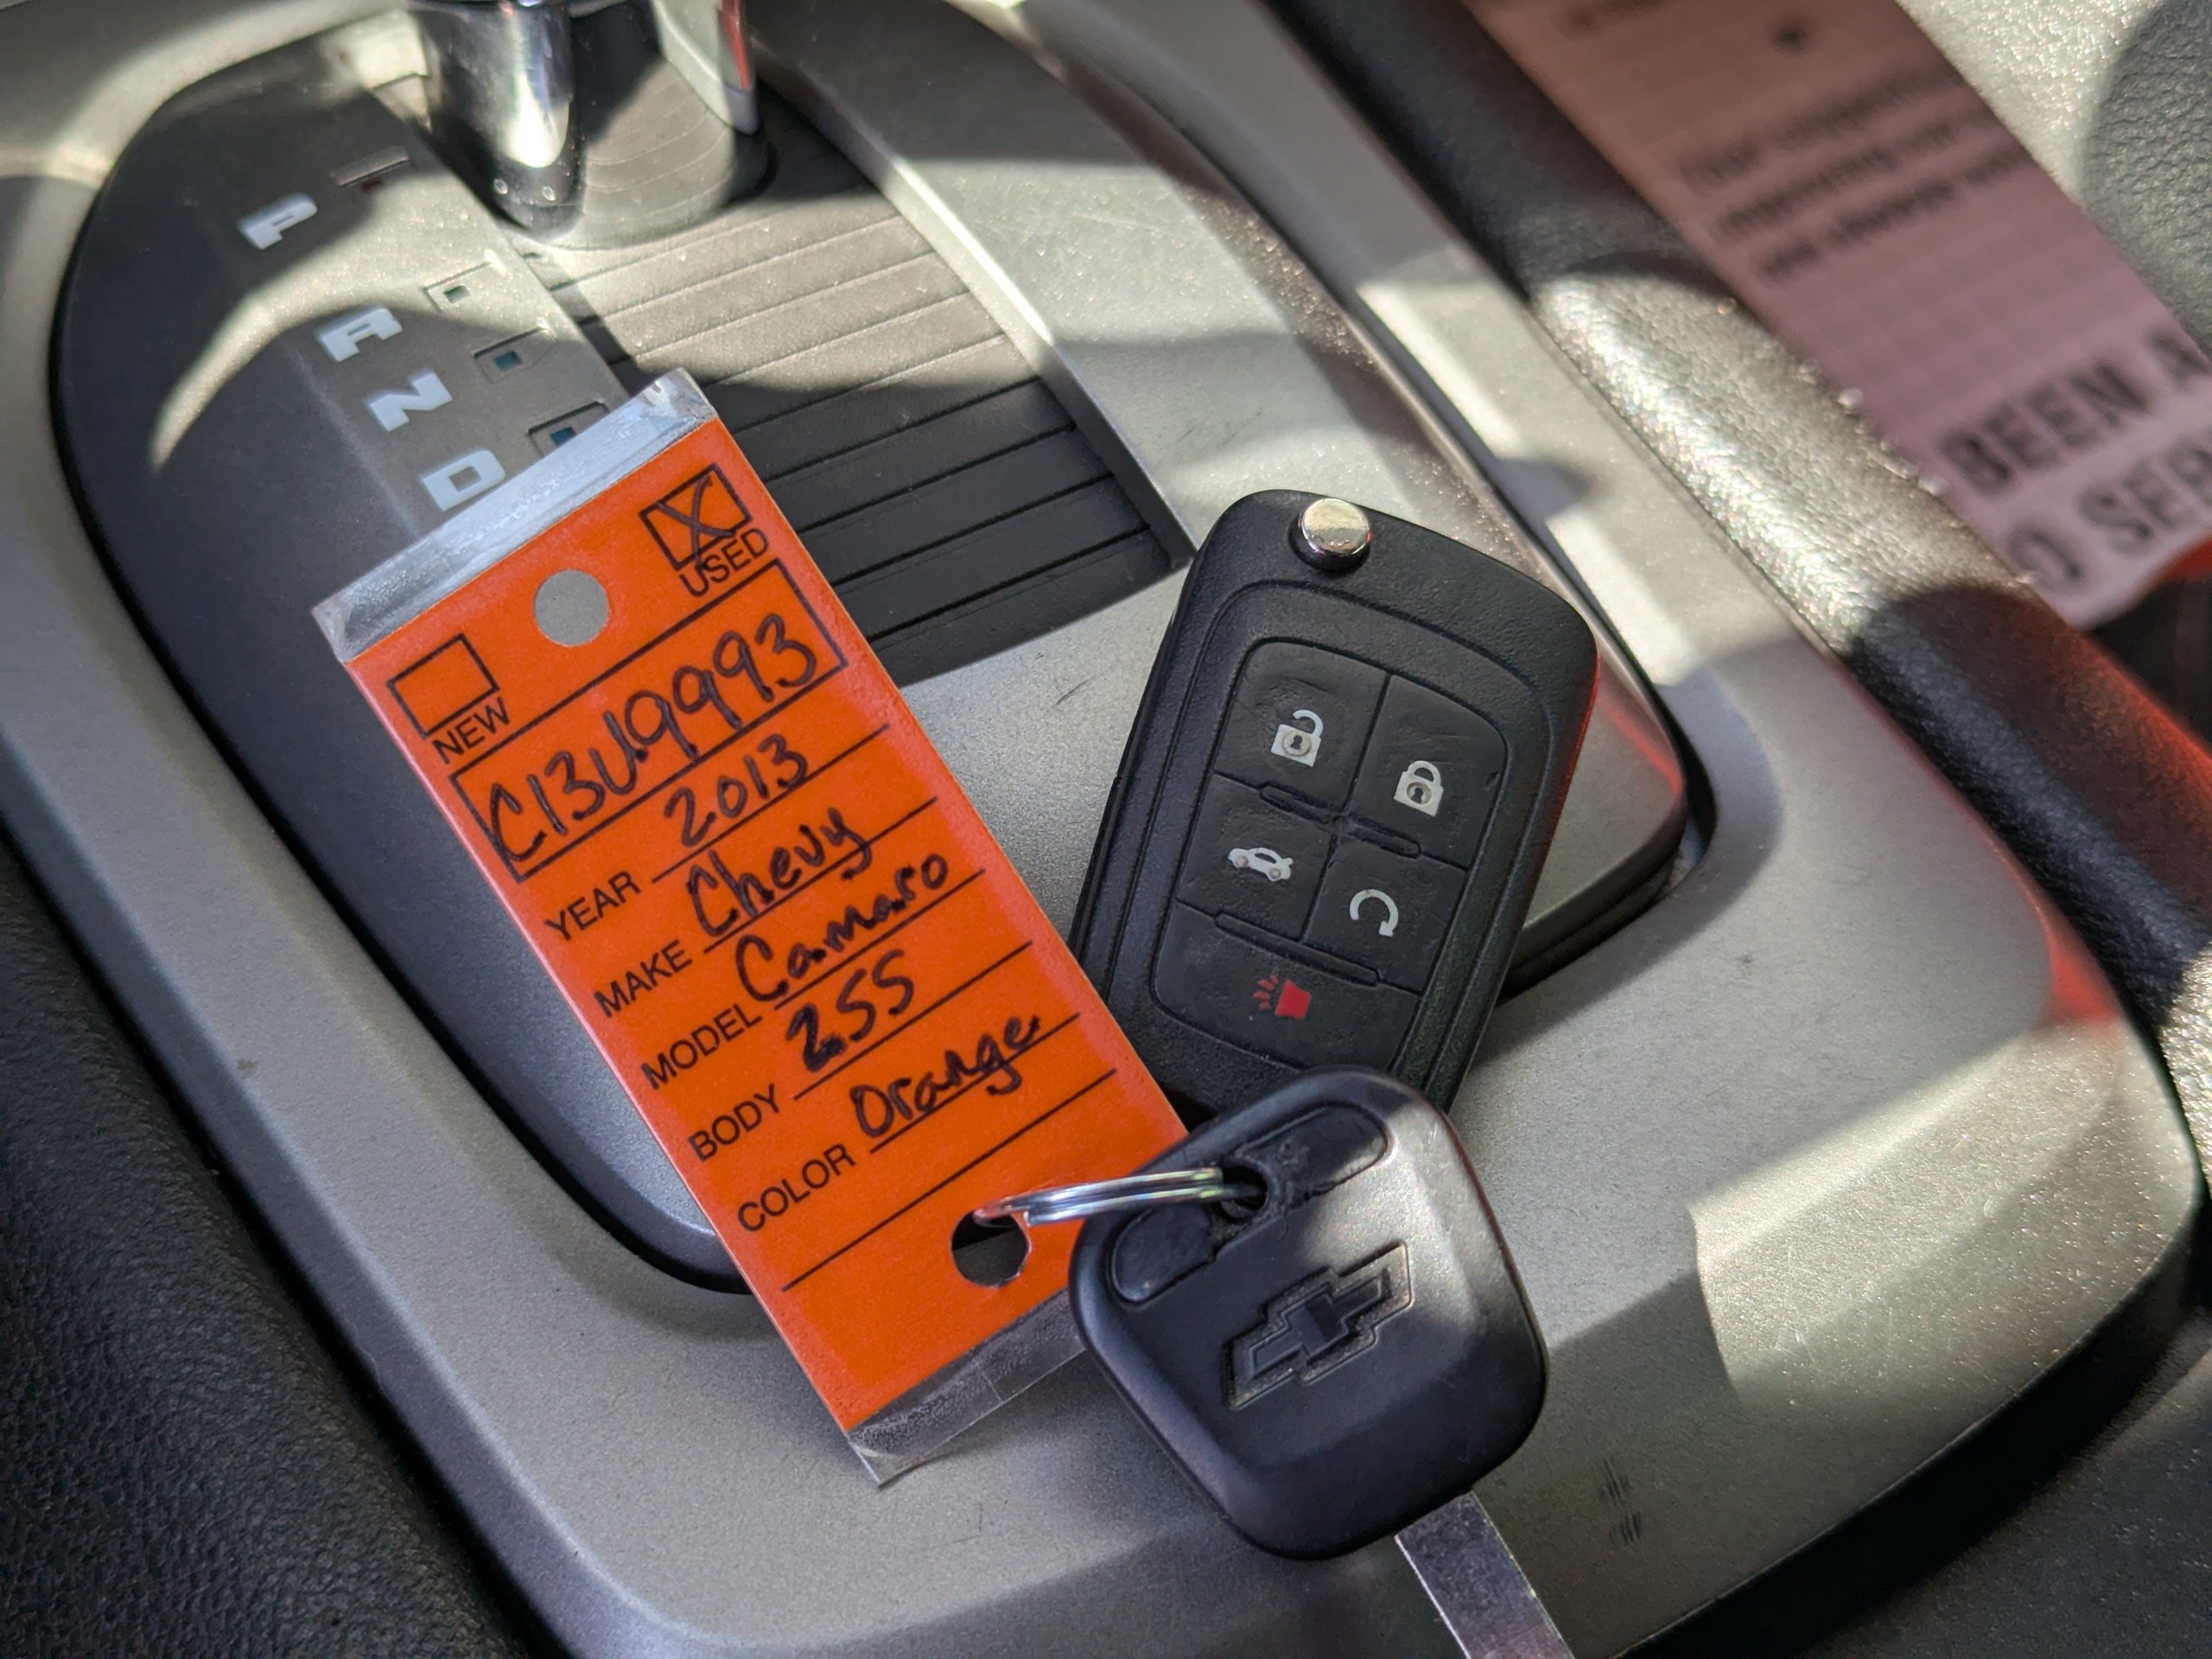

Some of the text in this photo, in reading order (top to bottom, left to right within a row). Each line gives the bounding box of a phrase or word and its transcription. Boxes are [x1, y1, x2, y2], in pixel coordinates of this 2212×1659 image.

[238, 193, 318, 250] P
[316, 307, 404, 364] R
[368, 372, 453, 432] N
[1936, 359, 2152, 496] BEEN
[421, 449, 506, 512] D
[680, 528, 771, 597] USED
[432, 696, 512, 764] NEW
[487, 613, 817, 863] C13U9993
[543, 733, 809, 943] YEAR 2013
[593, 806, 873, 1018] MAKE Chevy
[639, 853, 949, 1090] MODEL Camaro
[688, 1082, 783, 1163] BODY
[736, 1142, 857, 1234] COLOR
